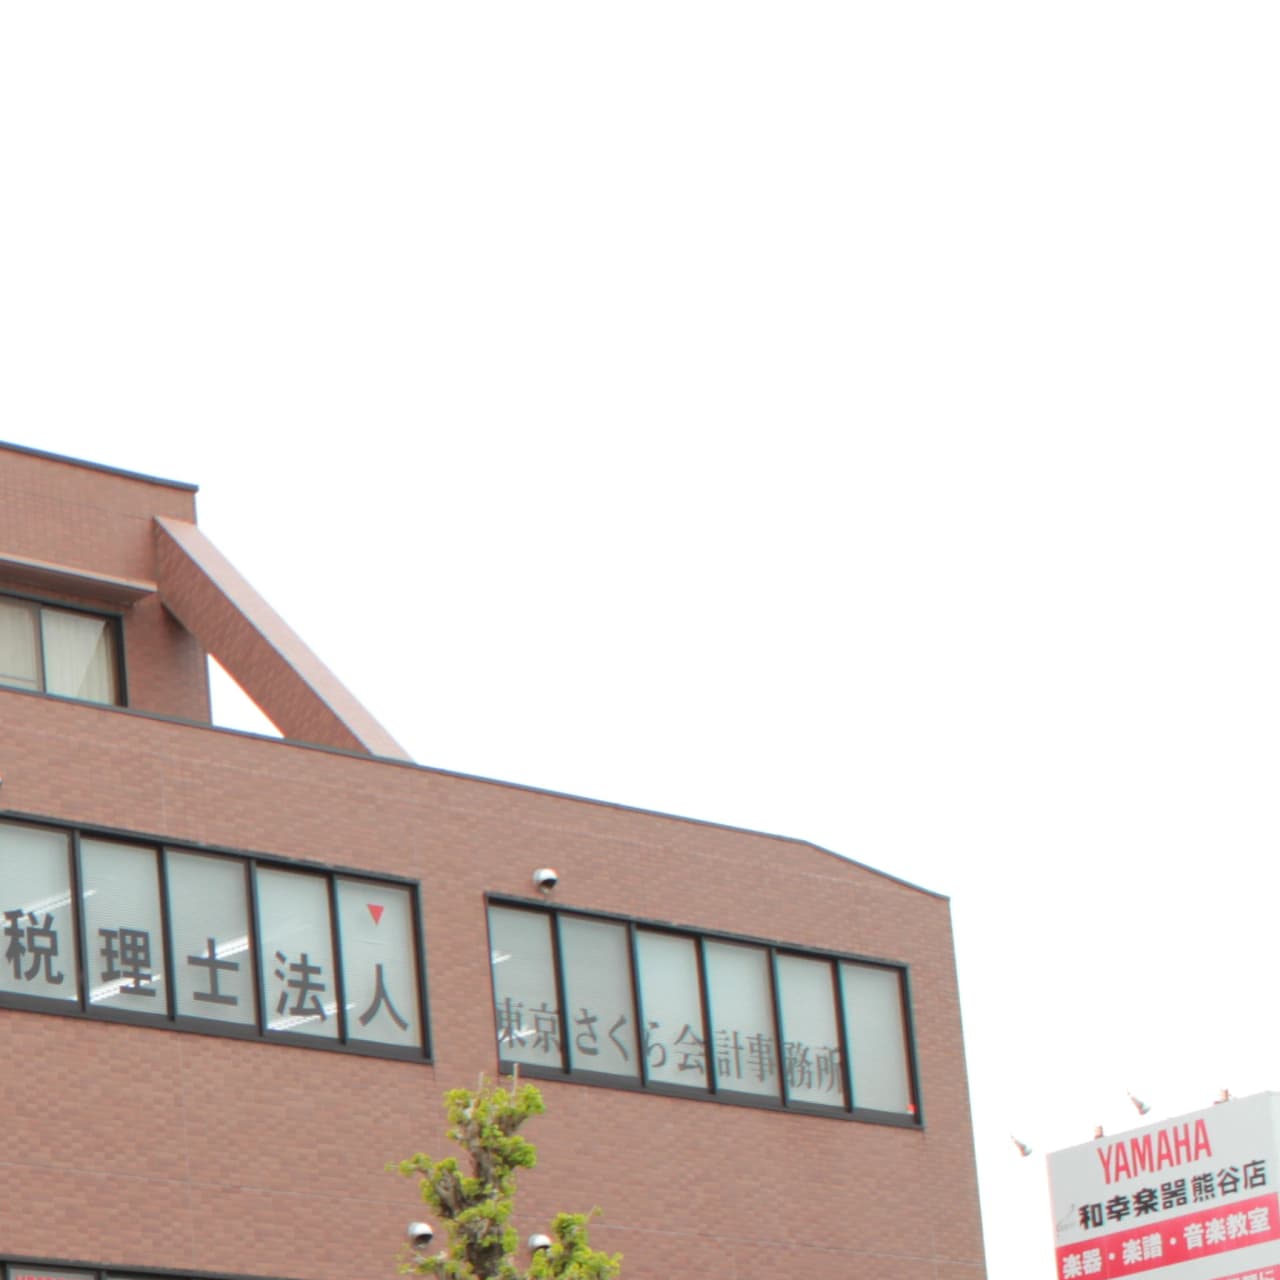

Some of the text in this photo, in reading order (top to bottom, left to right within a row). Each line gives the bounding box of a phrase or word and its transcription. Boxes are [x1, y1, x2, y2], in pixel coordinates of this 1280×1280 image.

[3, 908, 409, 1031] 税理士法人
[1097, 1119, 1213, 1185] YAMAHA
[1079, 1159, 1267, 1230] 和幸楽器熊谷店
[1062, 1207, 1271, 1279] 楽器・楽譜・音楽教室
